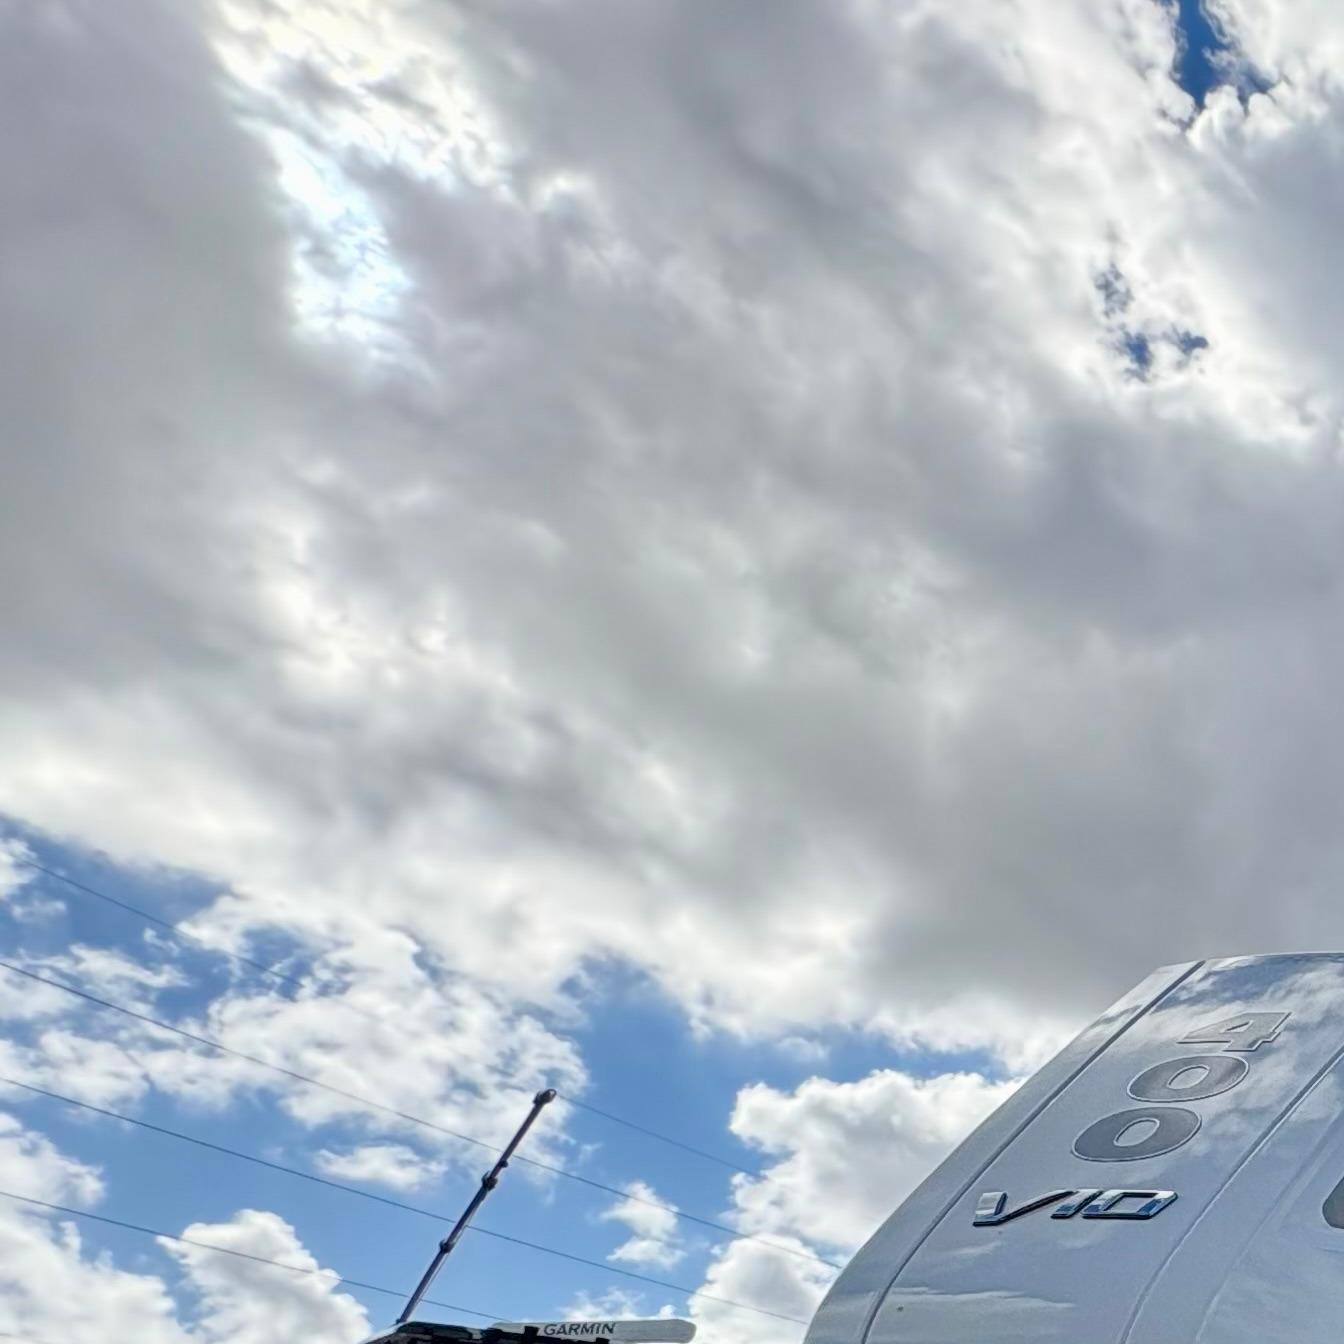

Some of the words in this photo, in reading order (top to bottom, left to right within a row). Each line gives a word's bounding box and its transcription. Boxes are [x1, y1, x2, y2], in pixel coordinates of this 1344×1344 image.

[1070, 1010, 1293, 1163] 400
[972, 1188, 1180, 1228] V10
[543, 1321, 617, 1336] GARMIN
